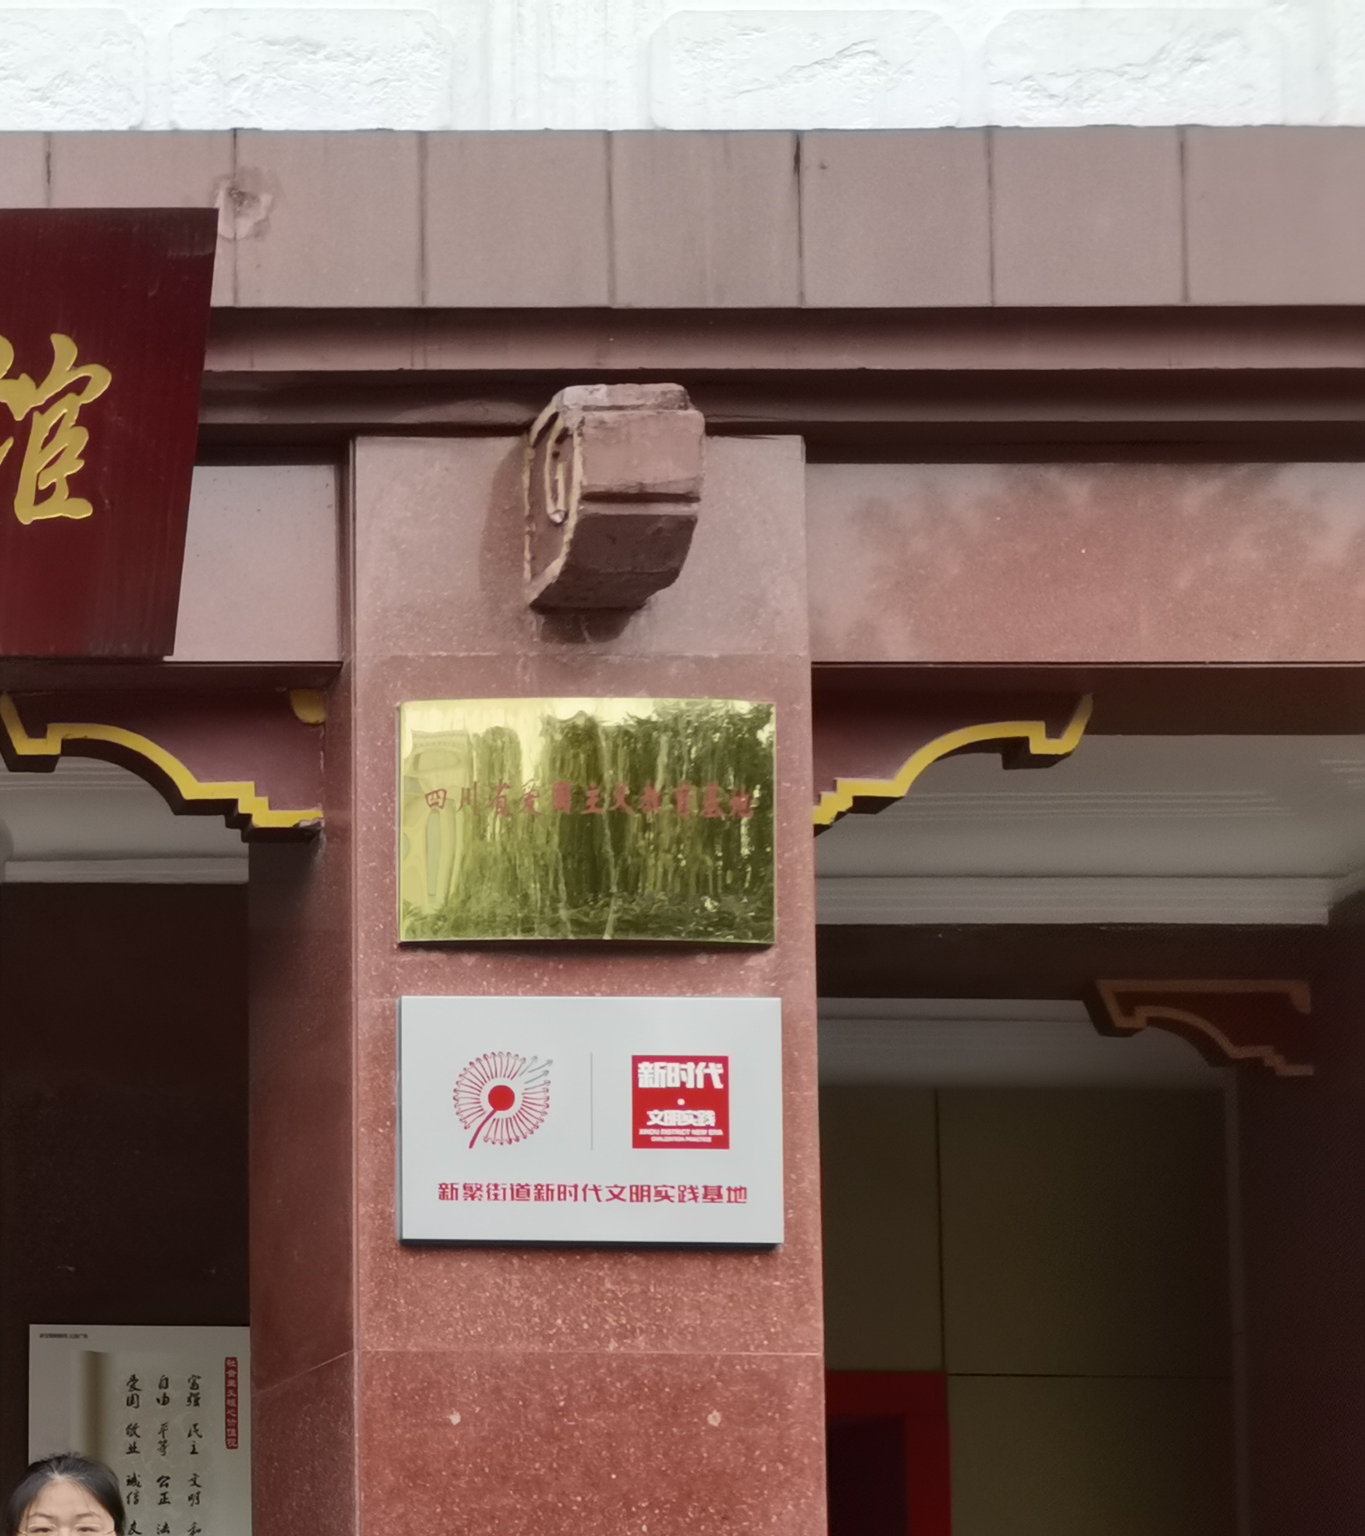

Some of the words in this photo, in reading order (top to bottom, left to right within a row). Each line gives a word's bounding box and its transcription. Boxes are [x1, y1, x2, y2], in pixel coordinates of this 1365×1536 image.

[638, 1062, 724, 1088] 新时代
[646, 1109, 716, 1126] 文明实践
[438, 1182, 748, 1204] 新繁街道新时代文明实践基地
